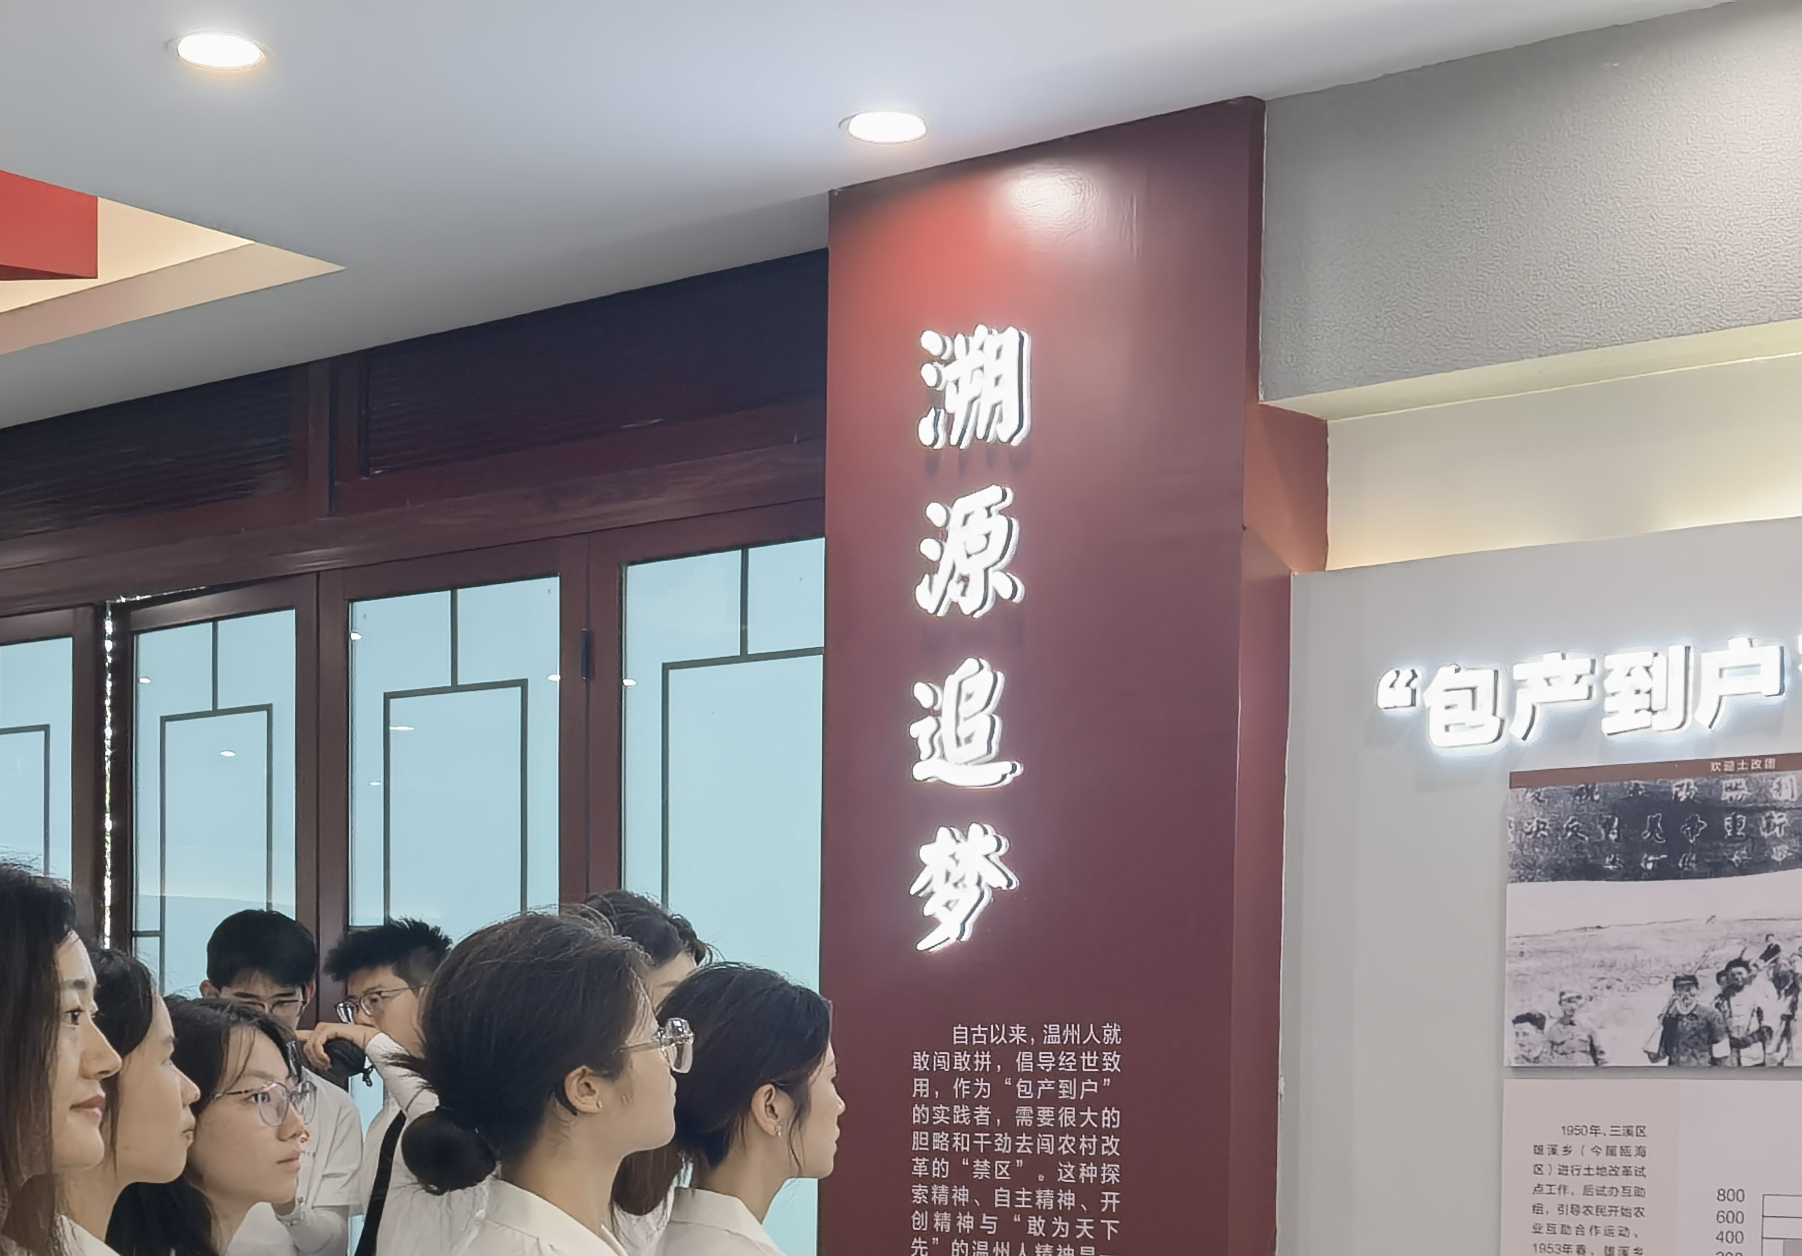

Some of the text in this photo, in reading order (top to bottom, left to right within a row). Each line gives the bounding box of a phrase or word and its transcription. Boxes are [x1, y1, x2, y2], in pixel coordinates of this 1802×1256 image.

[909, 323, 1031, 952] 溯源追梦
[1716, 1188, 1745, 1202] 800
[1716, 1210, 1745, 1224] 600
[1715, 1231, 1744, 1244] 400
